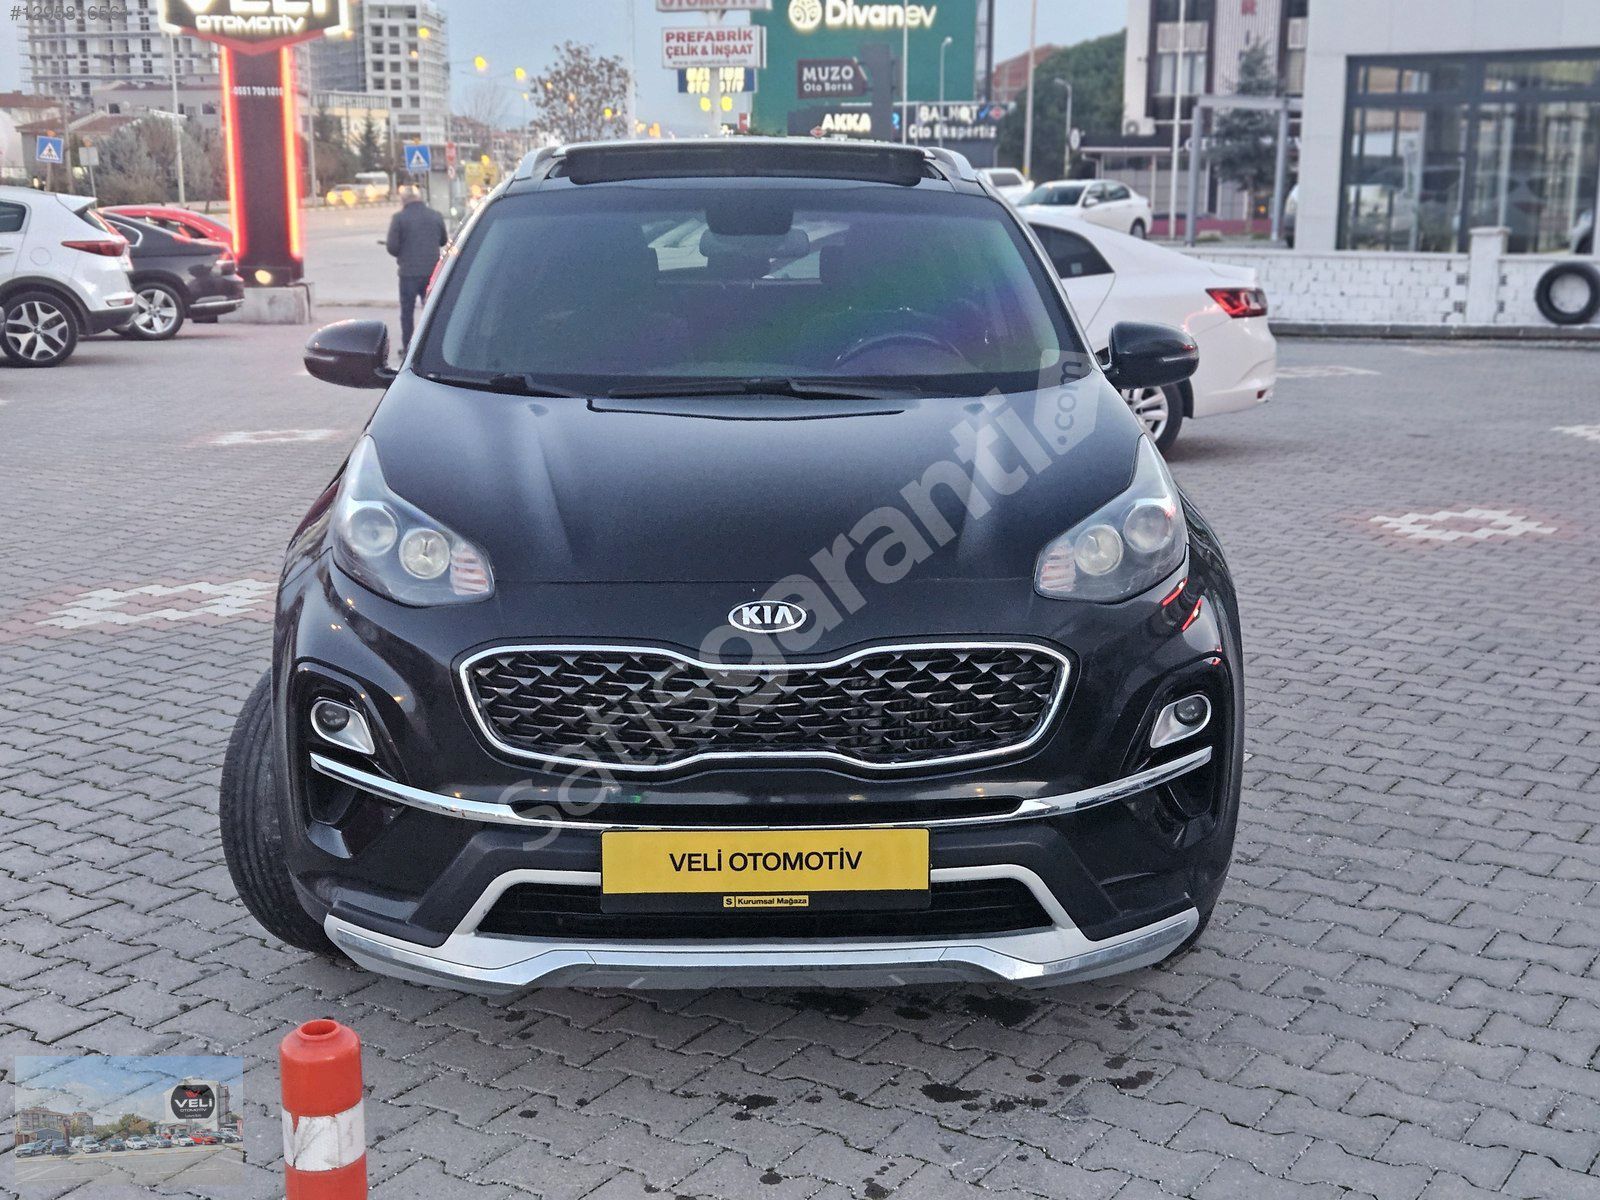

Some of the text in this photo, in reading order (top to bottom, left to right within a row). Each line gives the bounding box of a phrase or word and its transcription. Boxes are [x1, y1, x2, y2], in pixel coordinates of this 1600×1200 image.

[825, 0, 937, 27] Divanev
[802, 65, 854, 82] MUZO
[803, 82, 822, 92] Oto
[821, 112, 873, 132] AKKA
[742, 605, 795, 626] KIA
[669, 847, 862, 872] VELİ OTOMOTİV
[776, 897, 807, 905] Mağaza
